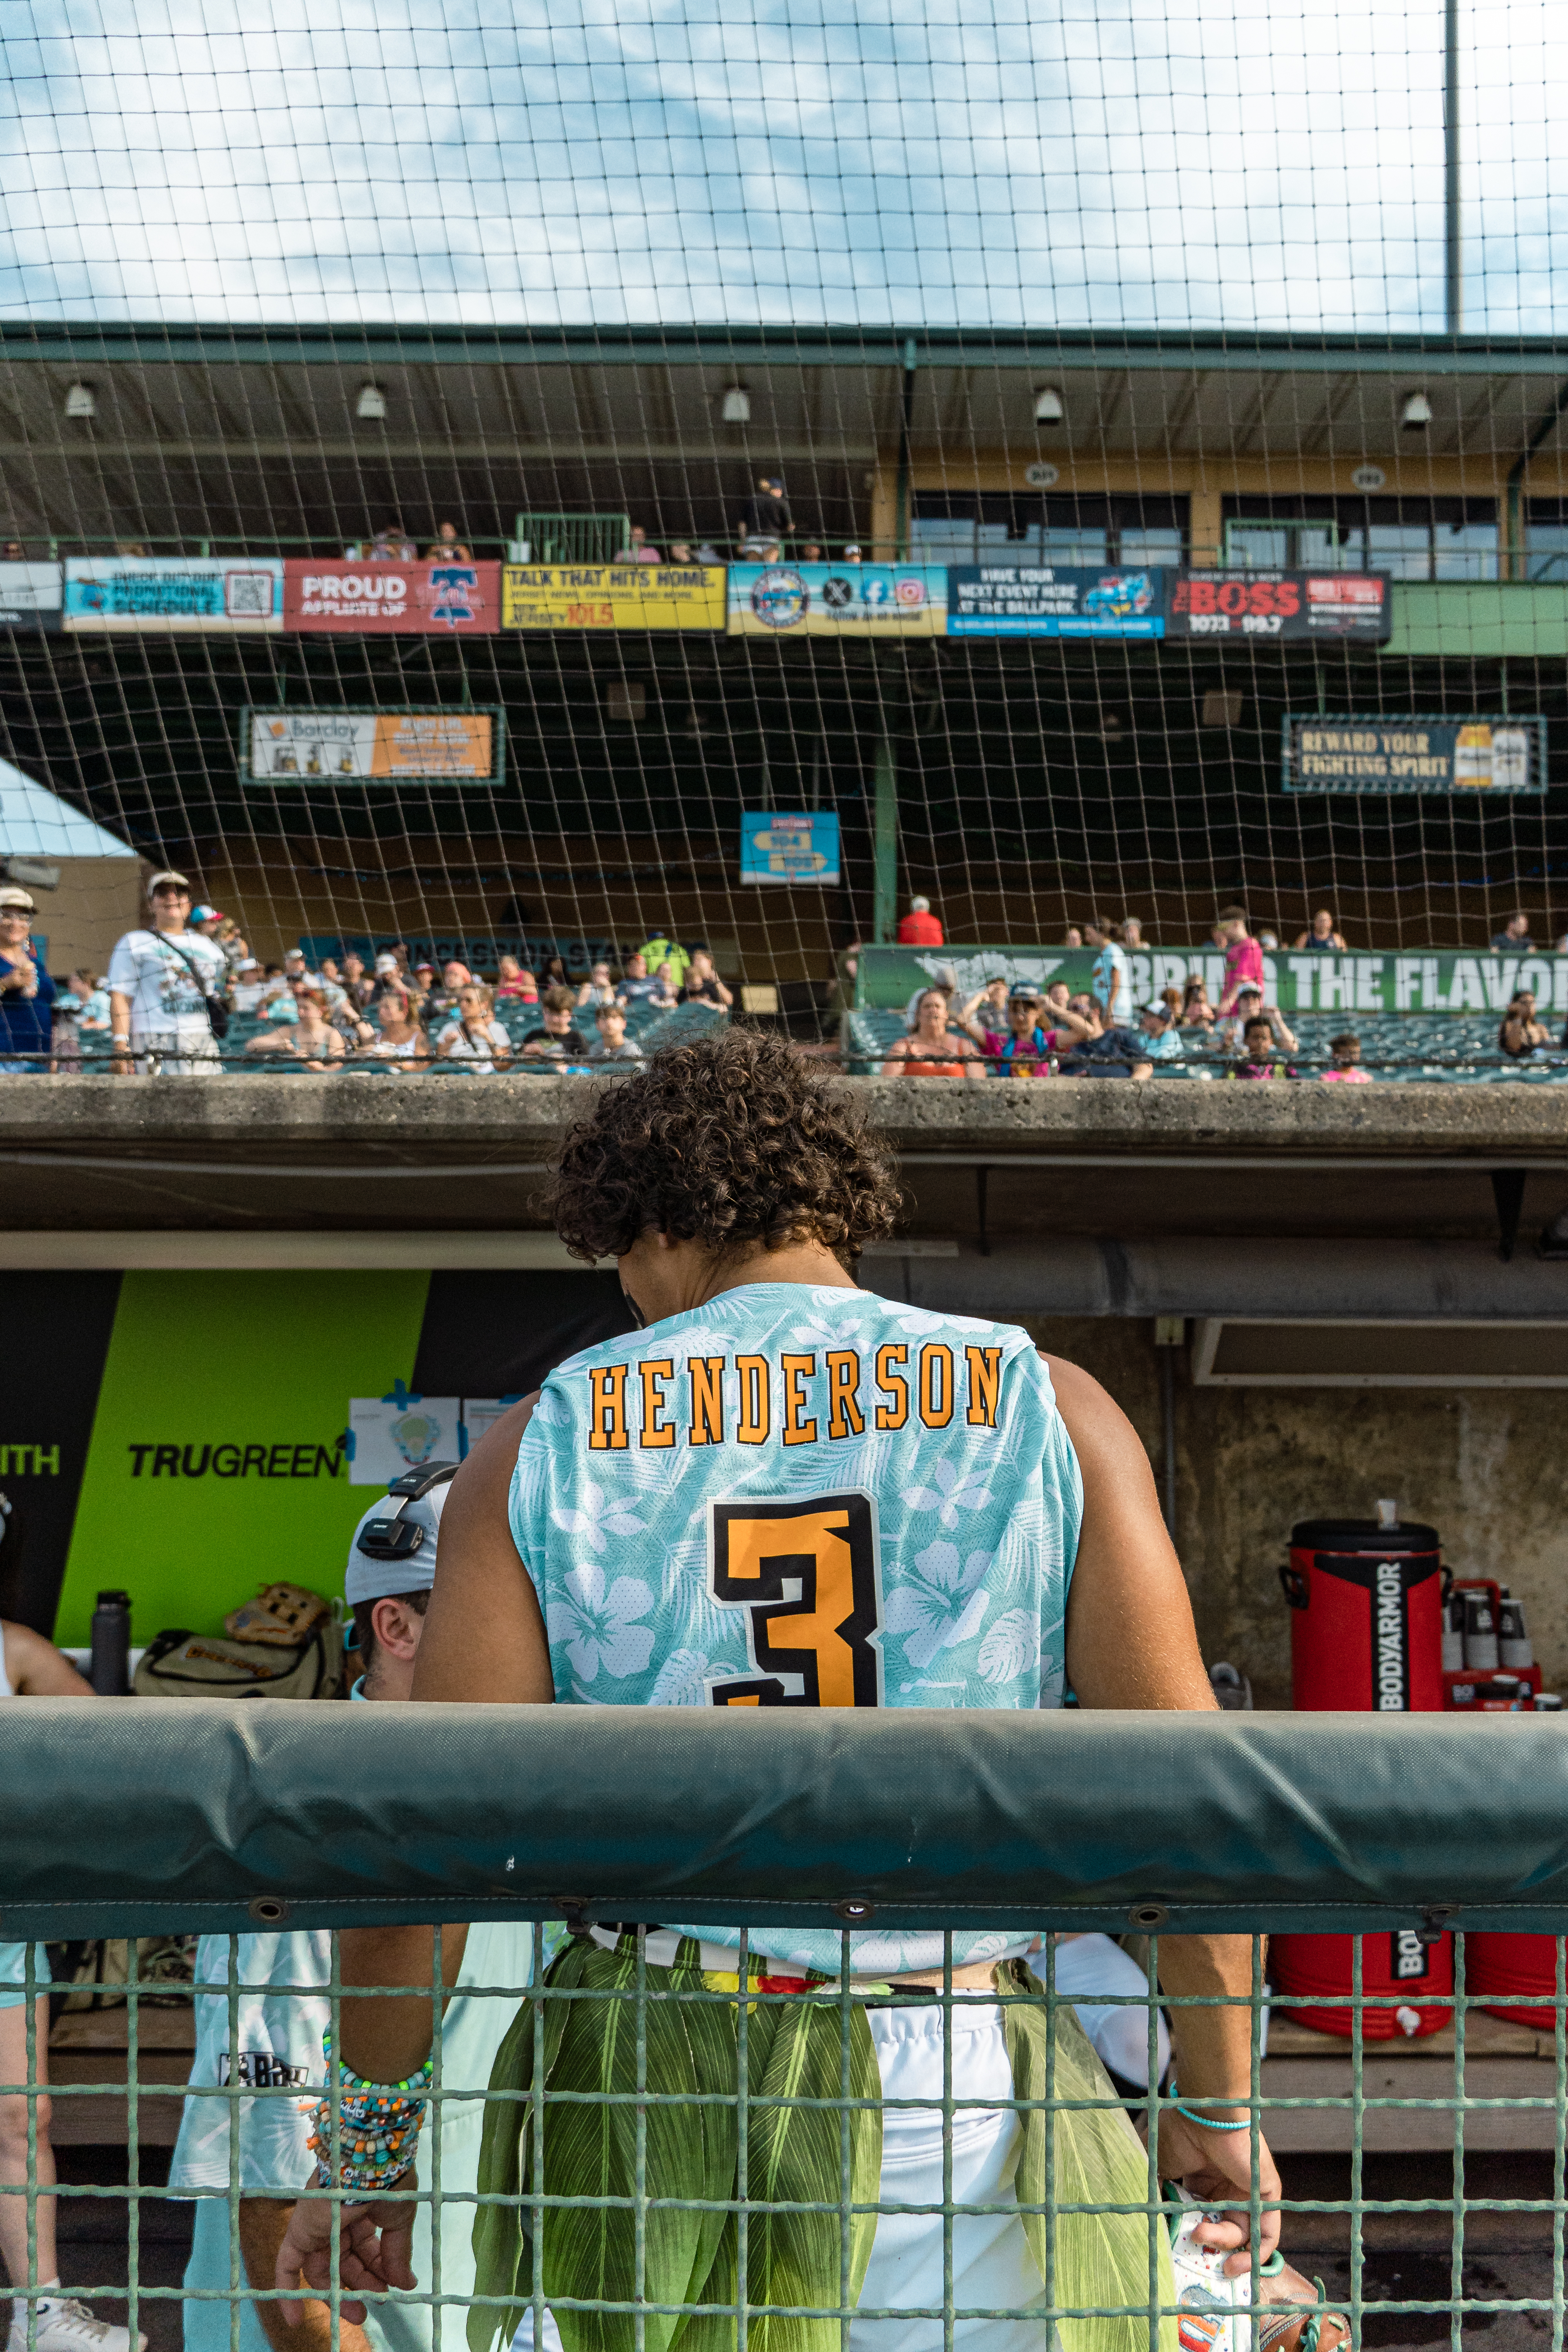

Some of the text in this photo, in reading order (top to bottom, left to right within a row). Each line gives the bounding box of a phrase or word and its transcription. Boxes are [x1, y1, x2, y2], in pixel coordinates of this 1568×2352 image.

[302, 576, 407, 599] PROUD
[510, 569, 552, 586] TALK
[560, 570, 602, 587] THAT
[610, 570, 650, 587] HITS
[1190, 581, 1300, 617] BOSS
[292, 717, 360, 741] Barclay
[1301, 731, 1430, 754] REWARD YOUR
[1301, 755, 1387, 776] FIGHTING
[1390, 756, 1450, 777] SPIRIT
[376, 943, 558, 965] CNCESSION
[1288, 957, 1384, 1009] THE
[587, 1342, 1004, 1451] HENDERSON
[129, 1444, 340, 1477] TRUGREEN
[709, 1490, 882, 1707] 3
[1376, 1562, 1403, 1711] BODYARMOR
